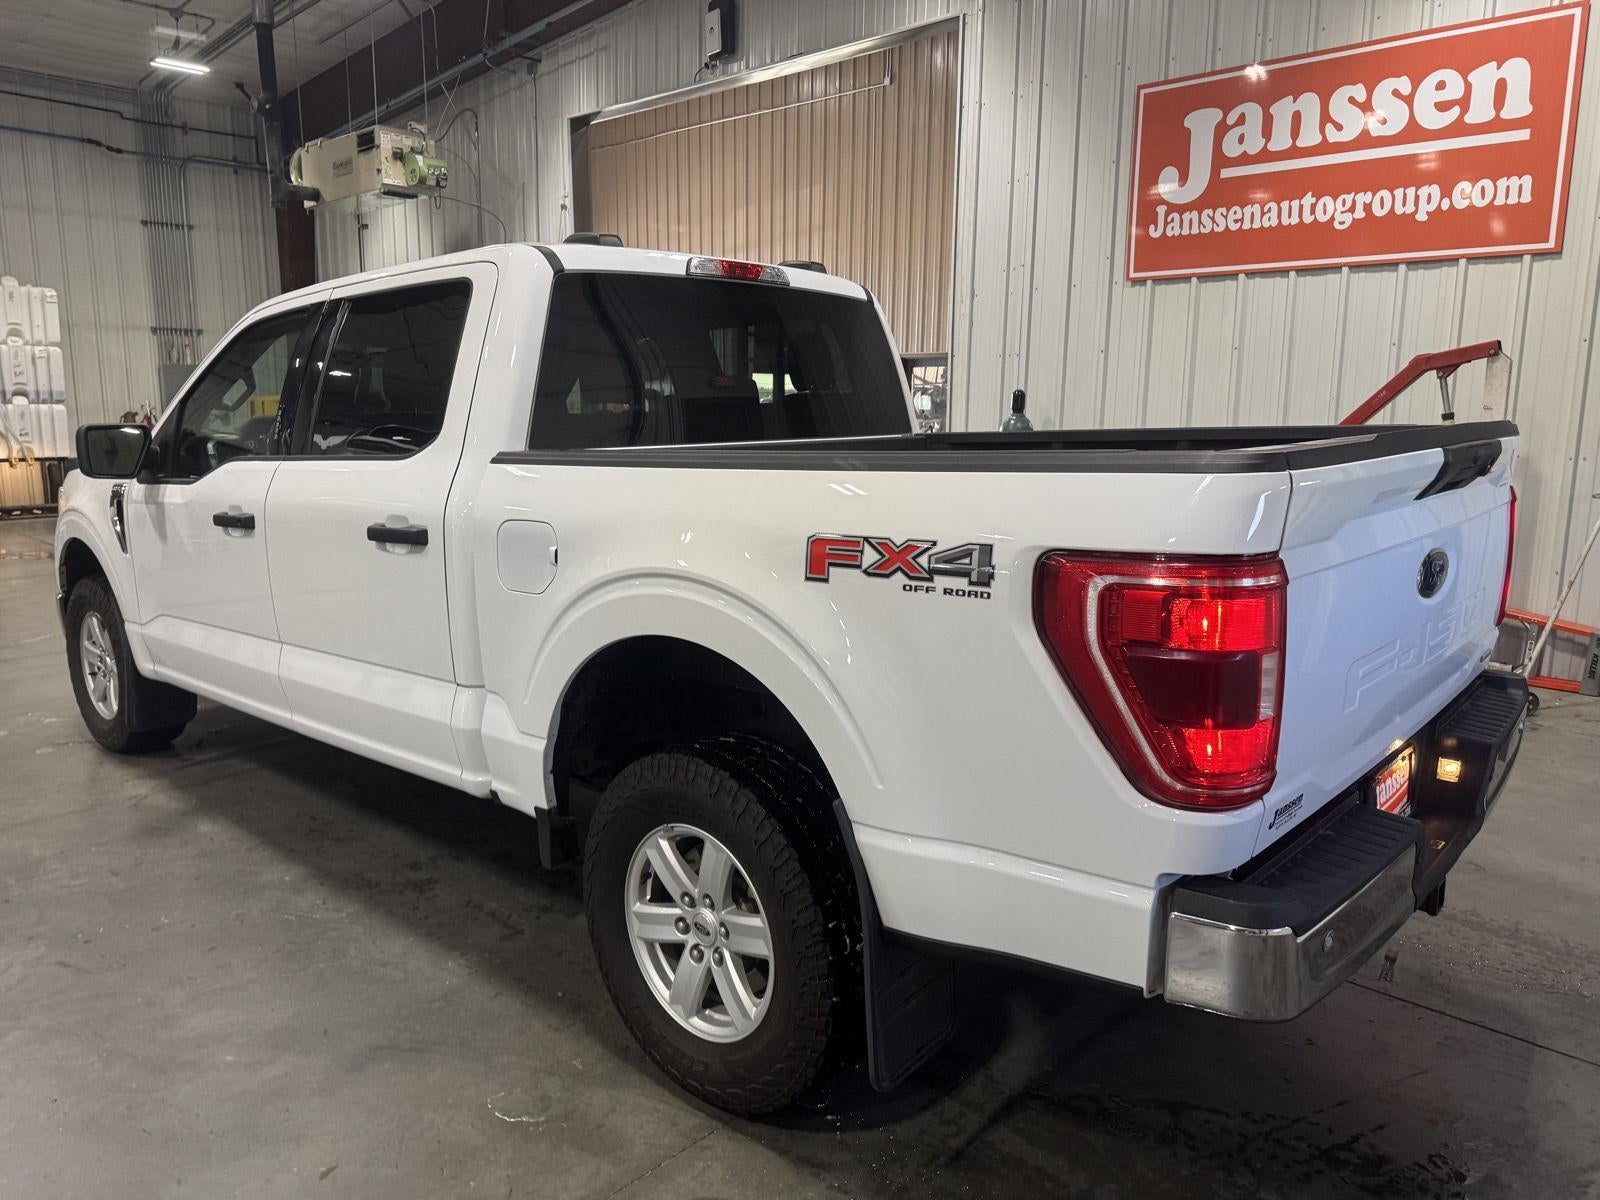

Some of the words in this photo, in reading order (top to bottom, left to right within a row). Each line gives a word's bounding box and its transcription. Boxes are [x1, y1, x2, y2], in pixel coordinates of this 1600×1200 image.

[1157, 56, 1534, 204] Janssen
[1148, 174, 1533, 238] Janssenautogroup.com
[804, 532, 995, 588] FX4
[902, 583, 937, 595] OFF
[943, 587, 992, 600] ROAD
